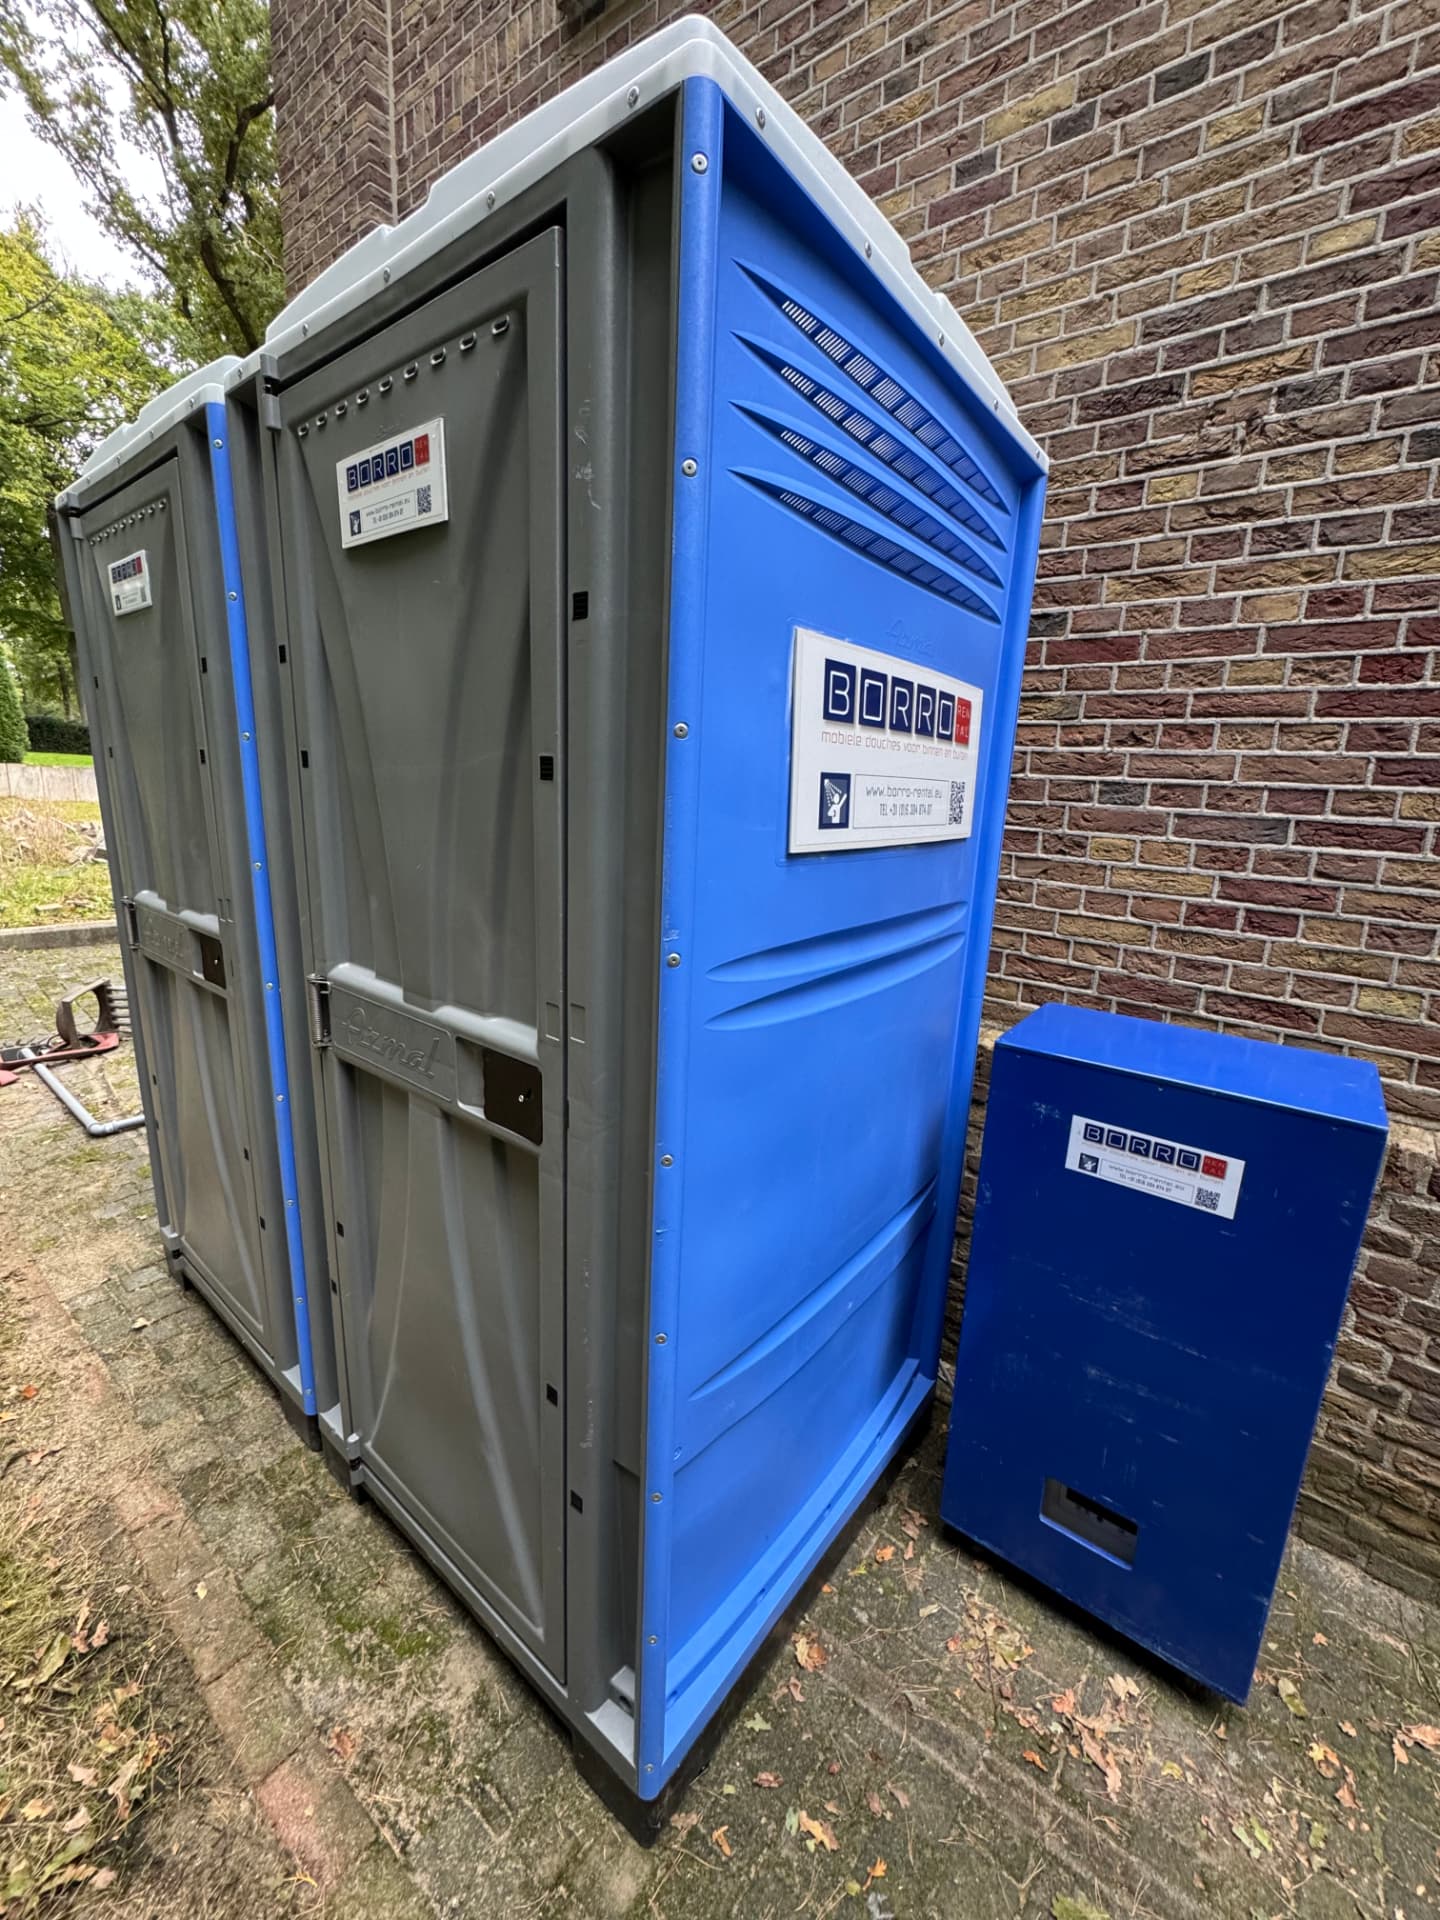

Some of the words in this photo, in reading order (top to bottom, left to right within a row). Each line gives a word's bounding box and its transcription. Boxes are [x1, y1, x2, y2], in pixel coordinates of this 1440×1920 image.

[348, 445, 413, 489] BORRO
[828, 669, 954, 736] BORRO
[957, 704, 971, 719] REN
[821, 731, 862, 747] mobiele
[865, 735, 902, 752] douches
[903, 742, 921, 754] voor
[865, 785, 943, 800] www.borro-rental.eu
[1085, 1125, 1198, 1170] BORRO
